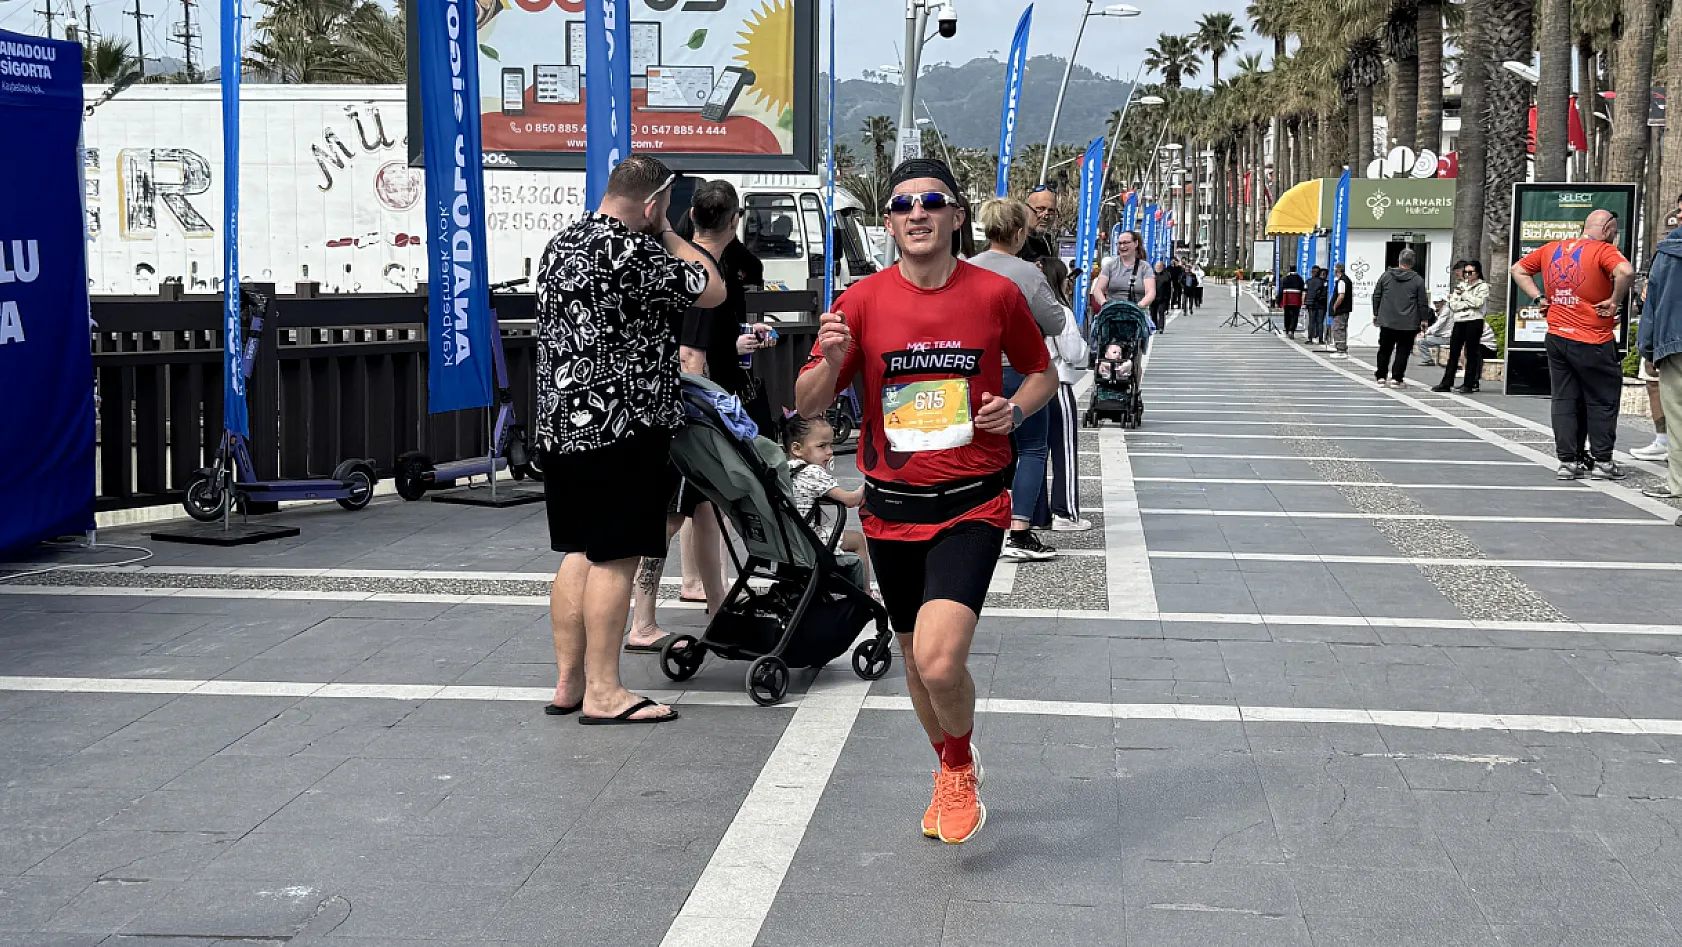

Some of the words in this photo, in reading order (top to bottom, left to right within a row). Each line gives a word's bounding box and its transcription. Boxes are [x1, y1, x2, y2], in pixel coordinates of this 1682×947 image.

[0, 40, 57, 61] ANADOLU
[0, 56, 53, 79] SİGORTA
[525, 124, 533, 134] 0
[535, 124, 556, 134] 850
[557, 124, 579, 134] 885
[641, 125, 651, 135] 0
[651, 125, 671, 135] 547
[673, 125, 694, 135] 885
[695, 125, 704, 135] 4
[705, 125, 727, 136] 444
[311, 100, 409, 191] MÜ
[488, 185, 585, 207] 35.436.05.
[1395, 196, 1453, 207] MARMARİS
[1558, 192, 1593, 203] SELECT
[1519, 306, 1544, 319] CİR
[906, 341, 932, 352] MAC
[934, 341, 961, 349] TEAM
[890, 354, 976, 372] RUNNERS
[914, 389, 947, 411] 615
